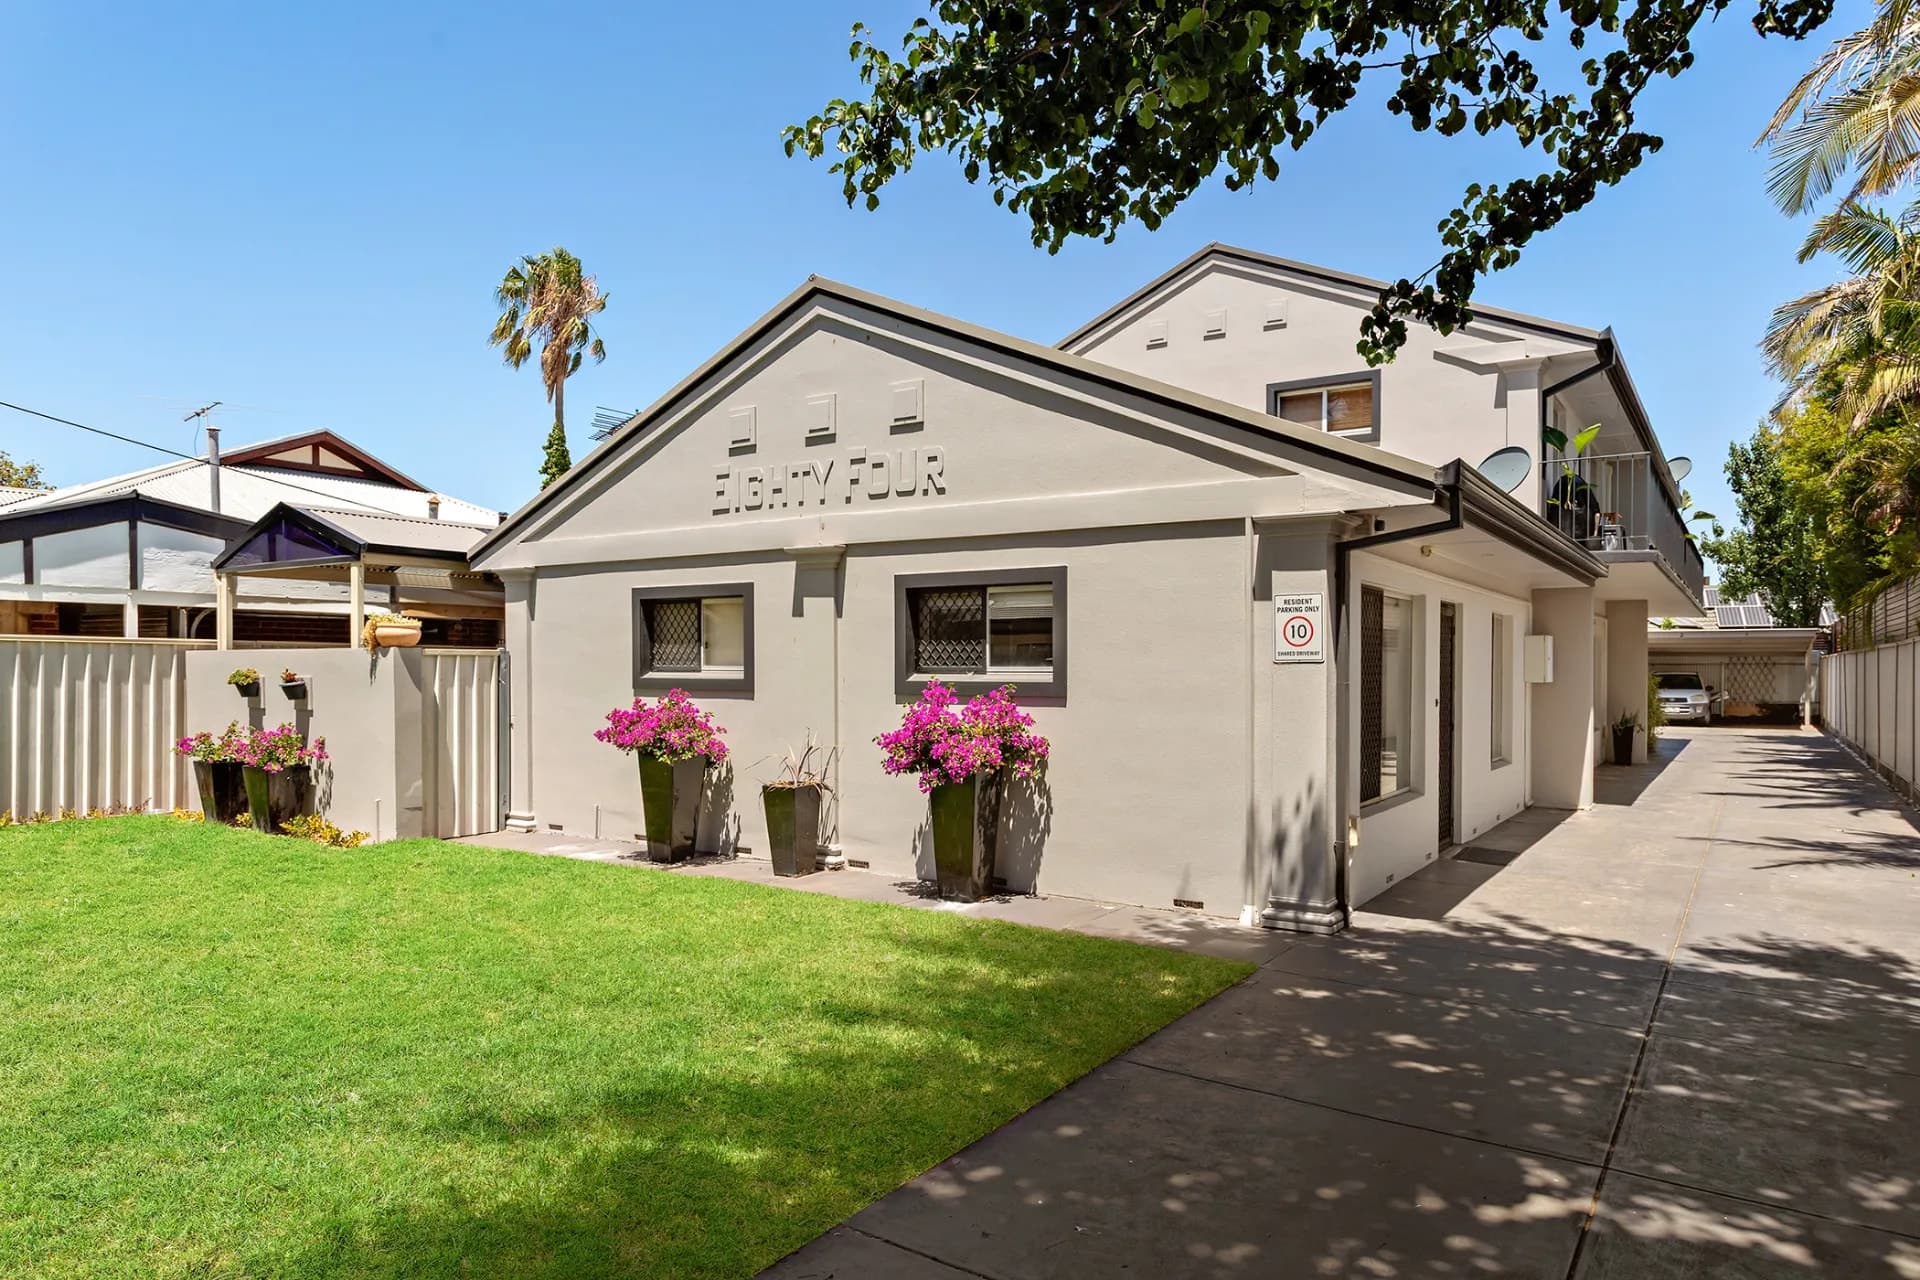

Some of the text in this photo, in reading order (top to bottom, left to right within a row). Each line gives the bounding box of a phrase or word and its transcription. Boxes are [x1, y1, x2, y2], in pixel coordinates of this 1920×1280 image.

[711, 445, 946, 515] EIGHTY FOUR
[1290, 624, 1307, 639] 10
